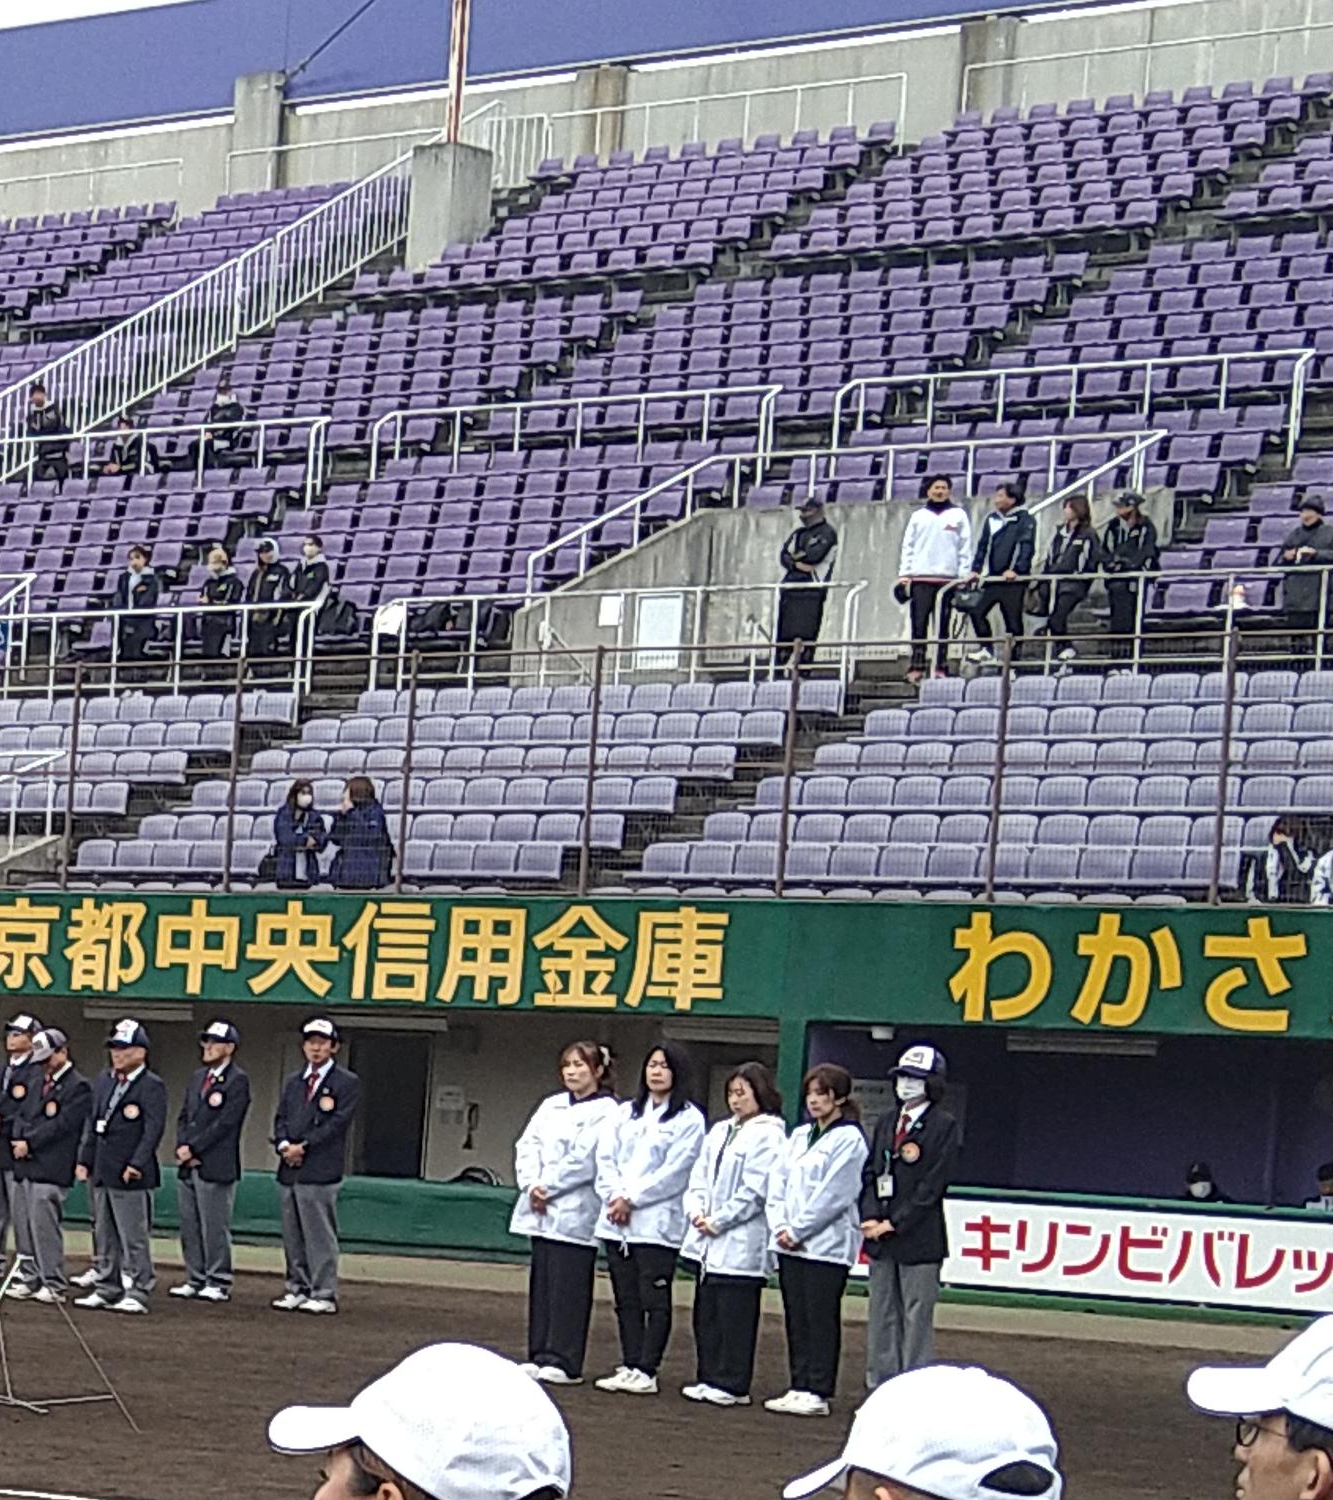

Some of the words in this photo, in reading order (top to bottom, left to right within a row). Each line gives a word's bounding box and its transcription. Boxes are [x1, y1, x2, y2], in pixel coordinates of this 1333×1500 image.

[949, 911, 1307, 1031] わかさ
[962, 1215, 1333, 1293] キリンビバレッ
